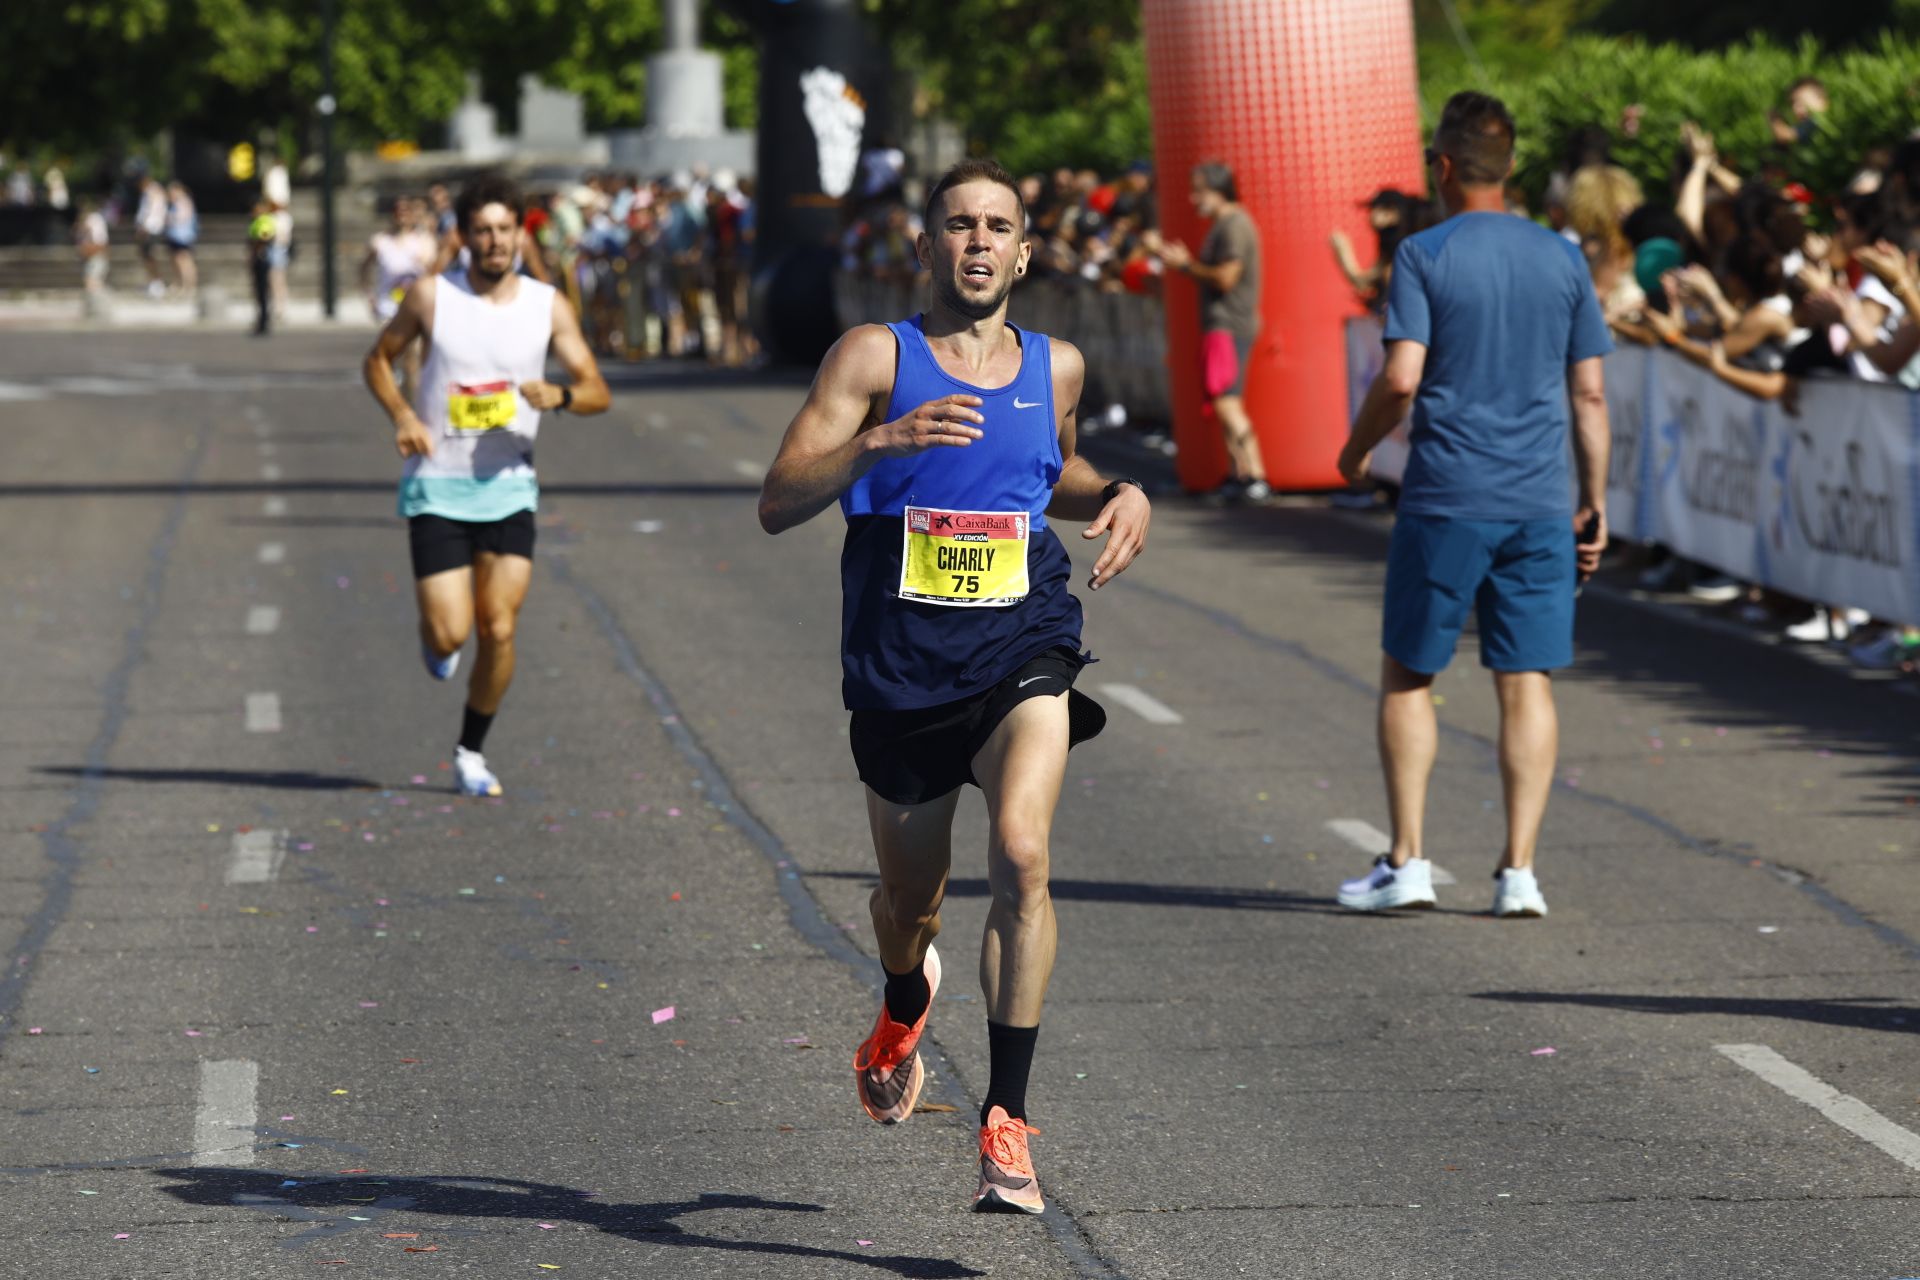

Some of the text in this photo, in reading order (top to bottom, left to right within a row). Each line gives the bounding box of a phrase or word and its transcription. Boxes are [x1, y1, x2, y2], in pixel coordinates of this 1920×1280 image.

[956, 516, 1010, 529] CaixaBank
[937, 546, 995, 571] CHARLY
[951, 575, 979, 593] 75
